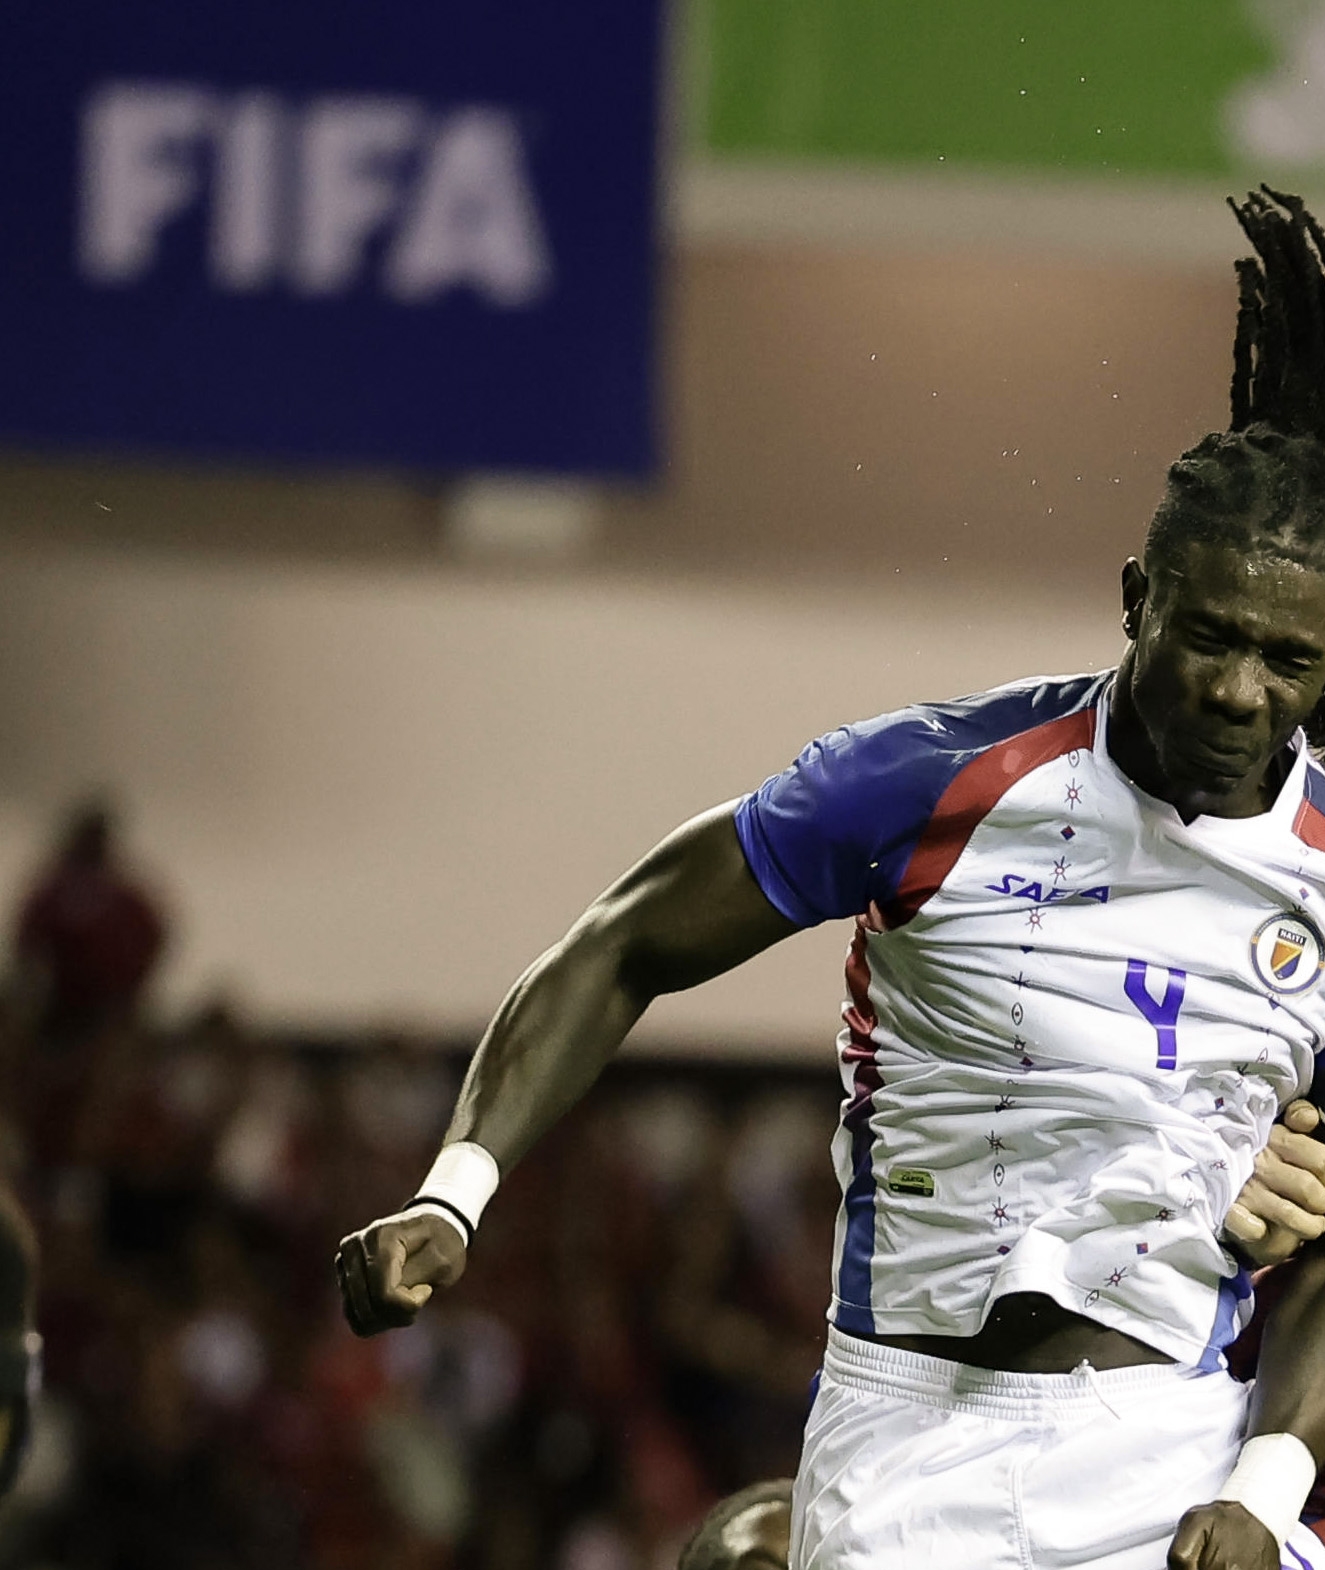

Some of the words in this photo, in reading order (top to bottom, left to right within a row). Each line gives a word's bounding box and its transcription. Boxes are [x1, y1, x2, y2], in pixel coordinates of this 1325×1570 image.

[80, 81, 553, 308] FIFA
[985, 874, 1110, 904] SAEA
[1279, 928, 1305, 945] HAITI
